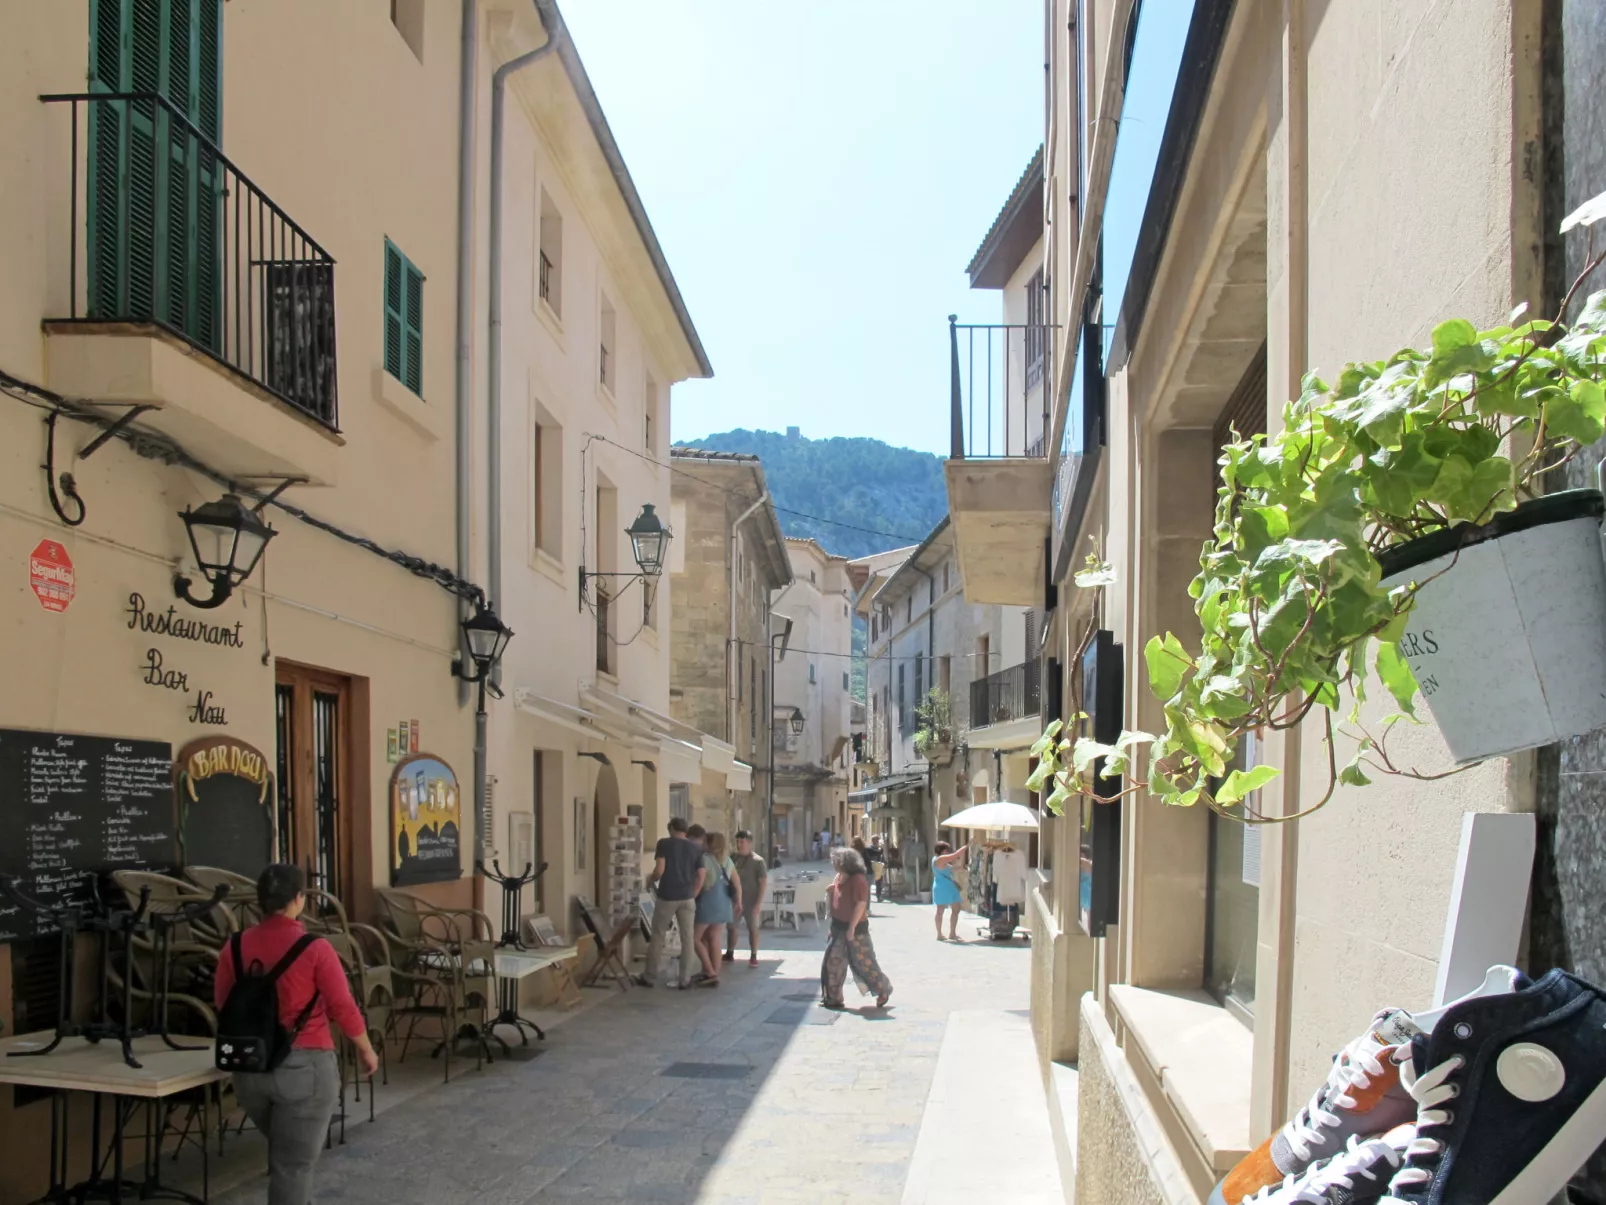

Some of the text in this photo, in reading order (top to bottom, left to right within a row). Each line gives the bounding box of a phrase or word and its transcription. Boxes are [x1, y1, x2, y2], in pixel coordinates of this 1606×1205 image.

[126, 592, 243, 648] Restaurant
[1400, 629, 1439, 657] ERS
[142, 648, 190, 692] Bar
[1422, 674, 1440, 695] EN
[188, 690, 228, 725] Nou
[194, 745, 229, 777] BAR
